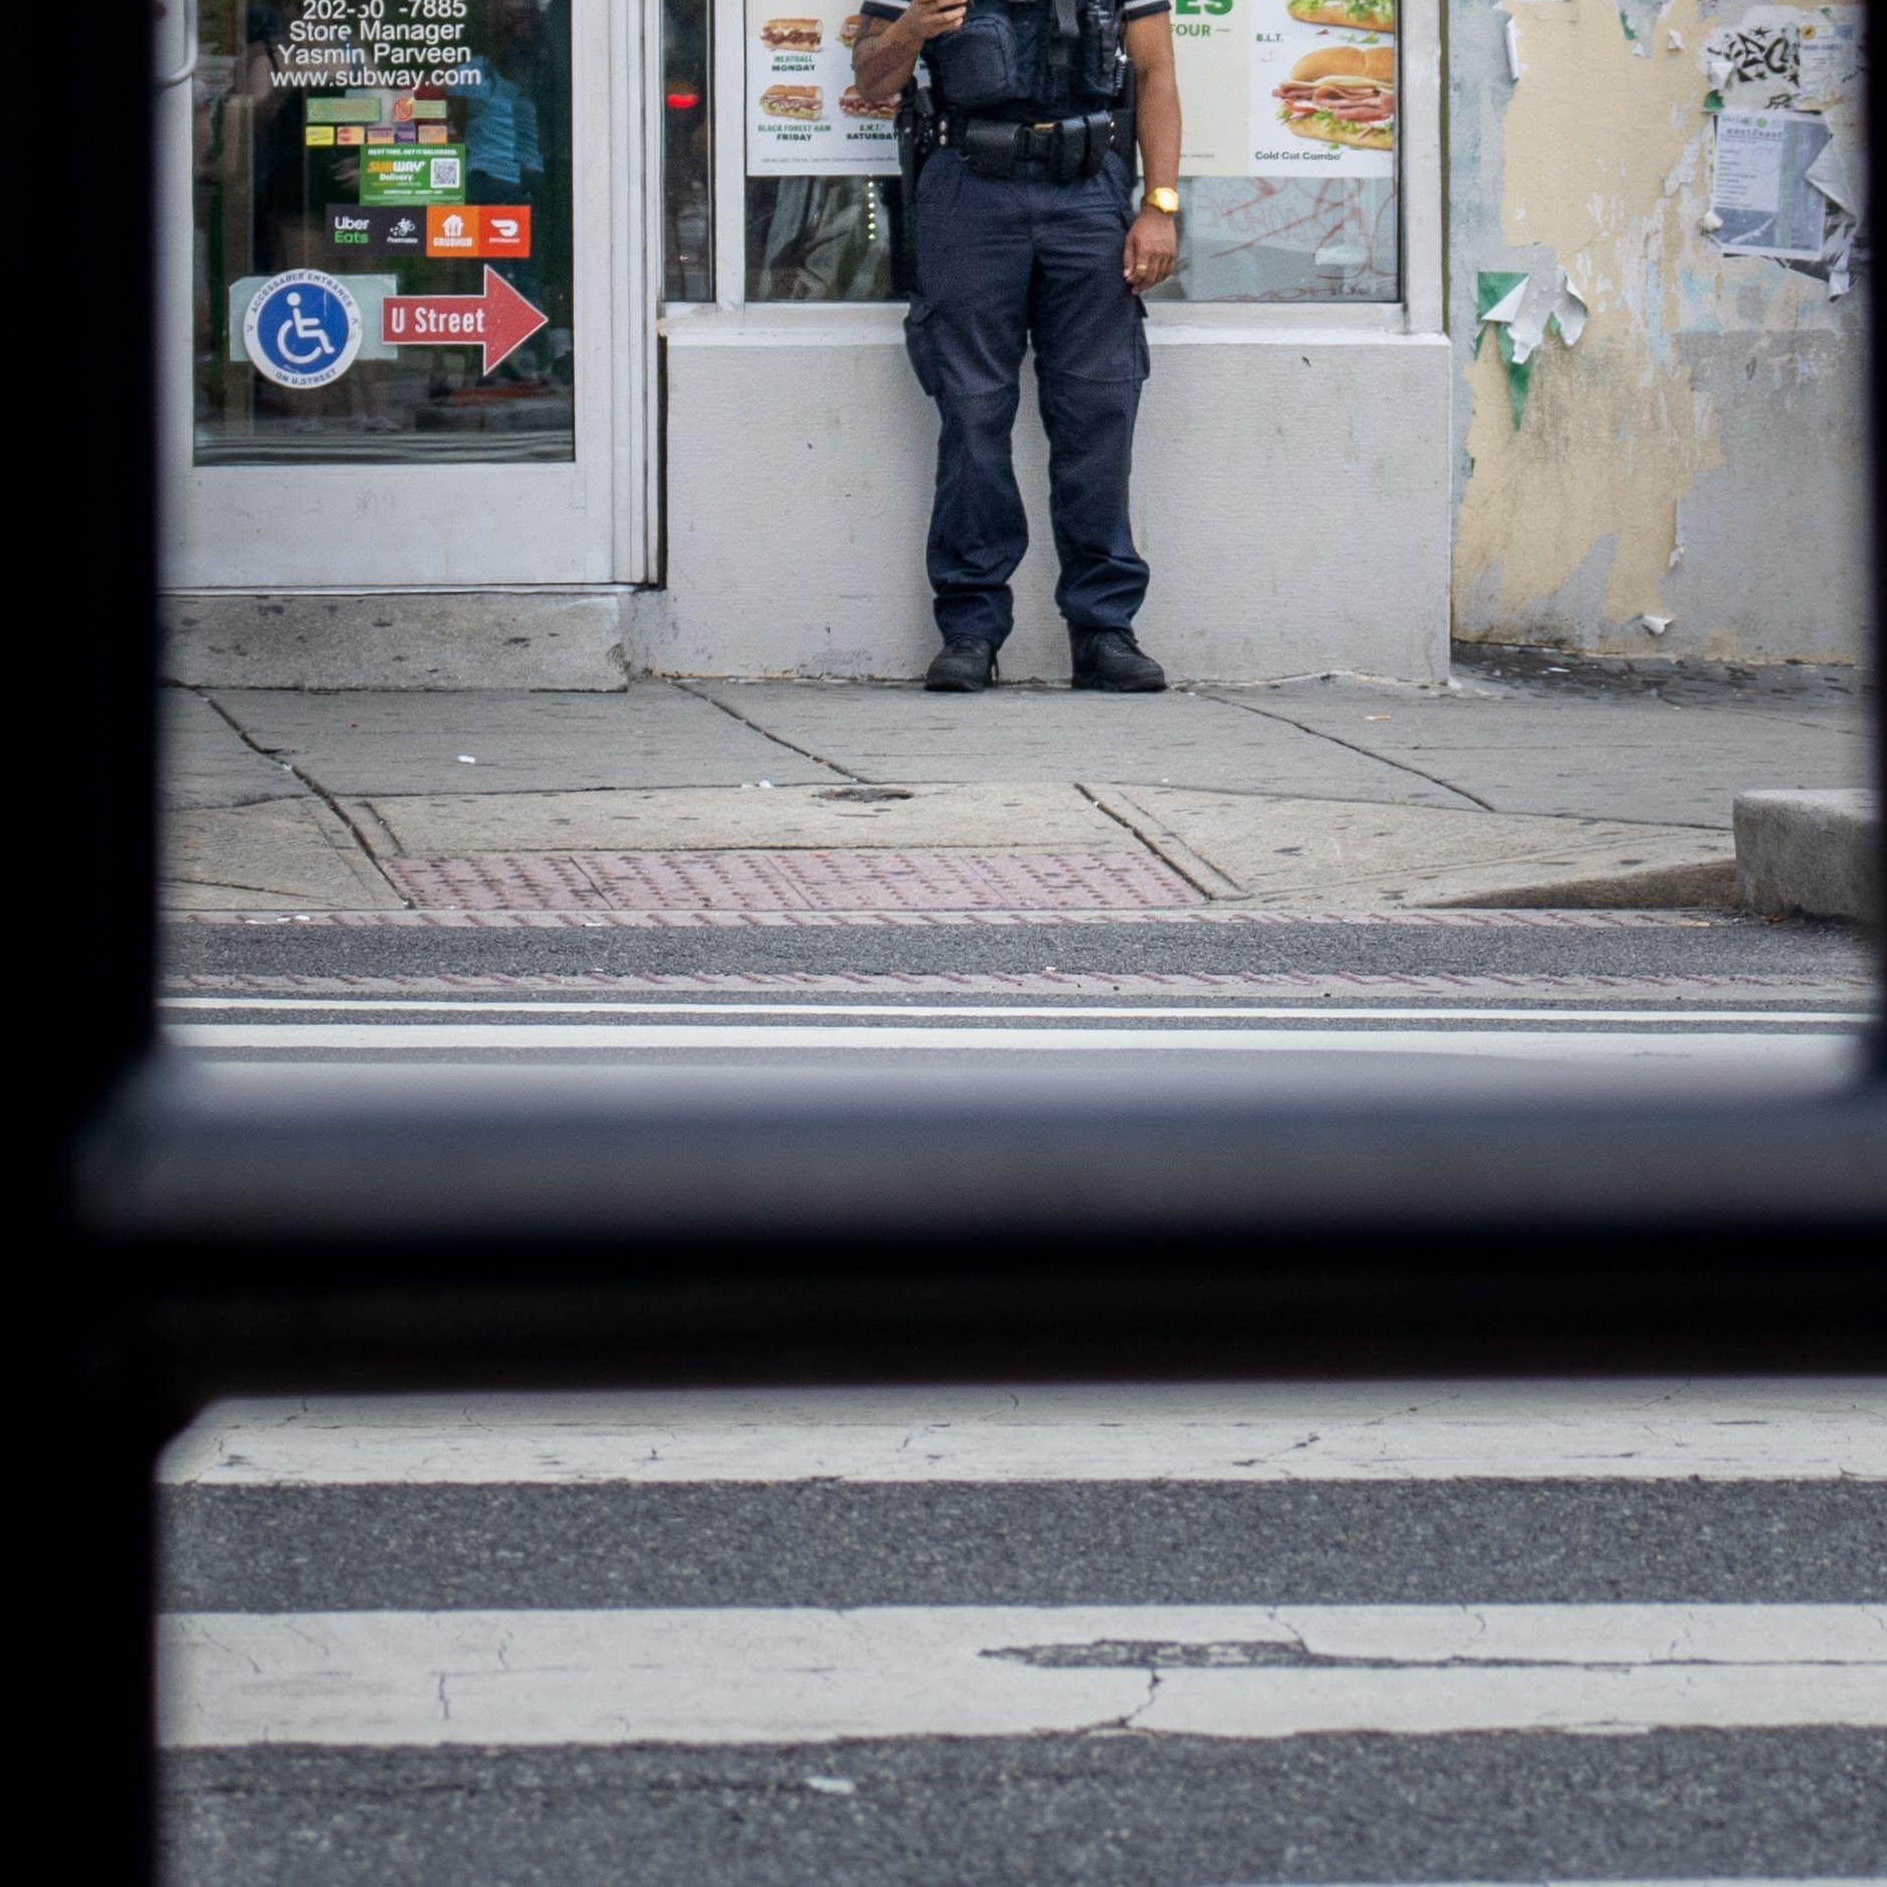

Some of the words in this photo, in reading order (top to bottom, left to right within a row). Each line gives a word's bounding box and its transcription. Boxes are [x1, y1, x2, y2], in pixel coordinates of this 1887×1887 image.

[290, 20, 352, 42] Store
[360, 20, 464, 45] Manager
[1255, 34, 1284, 42] B.L.T.
[278, 44, 365, 65] Yasmin
[374, 42, 471, 63] Parveen
[270, 67, 482, 90] www.subway.com
[1255, 151, 1279, 160] Cold
[1281, 151, 1300, 160] Cut
[1303, 152, 1340, 161] Combo
[367, 161, 424, 173] SUBWAY
[379, 173, 413, 182] Delivery
[335, 216, 370, 230] Uber
[334, 231, 369, 244] Eats
[307, 273, 353, 307] ENTRANCE
[391, 308, 405, 333] U
[415, 307, 485, 334] Street
